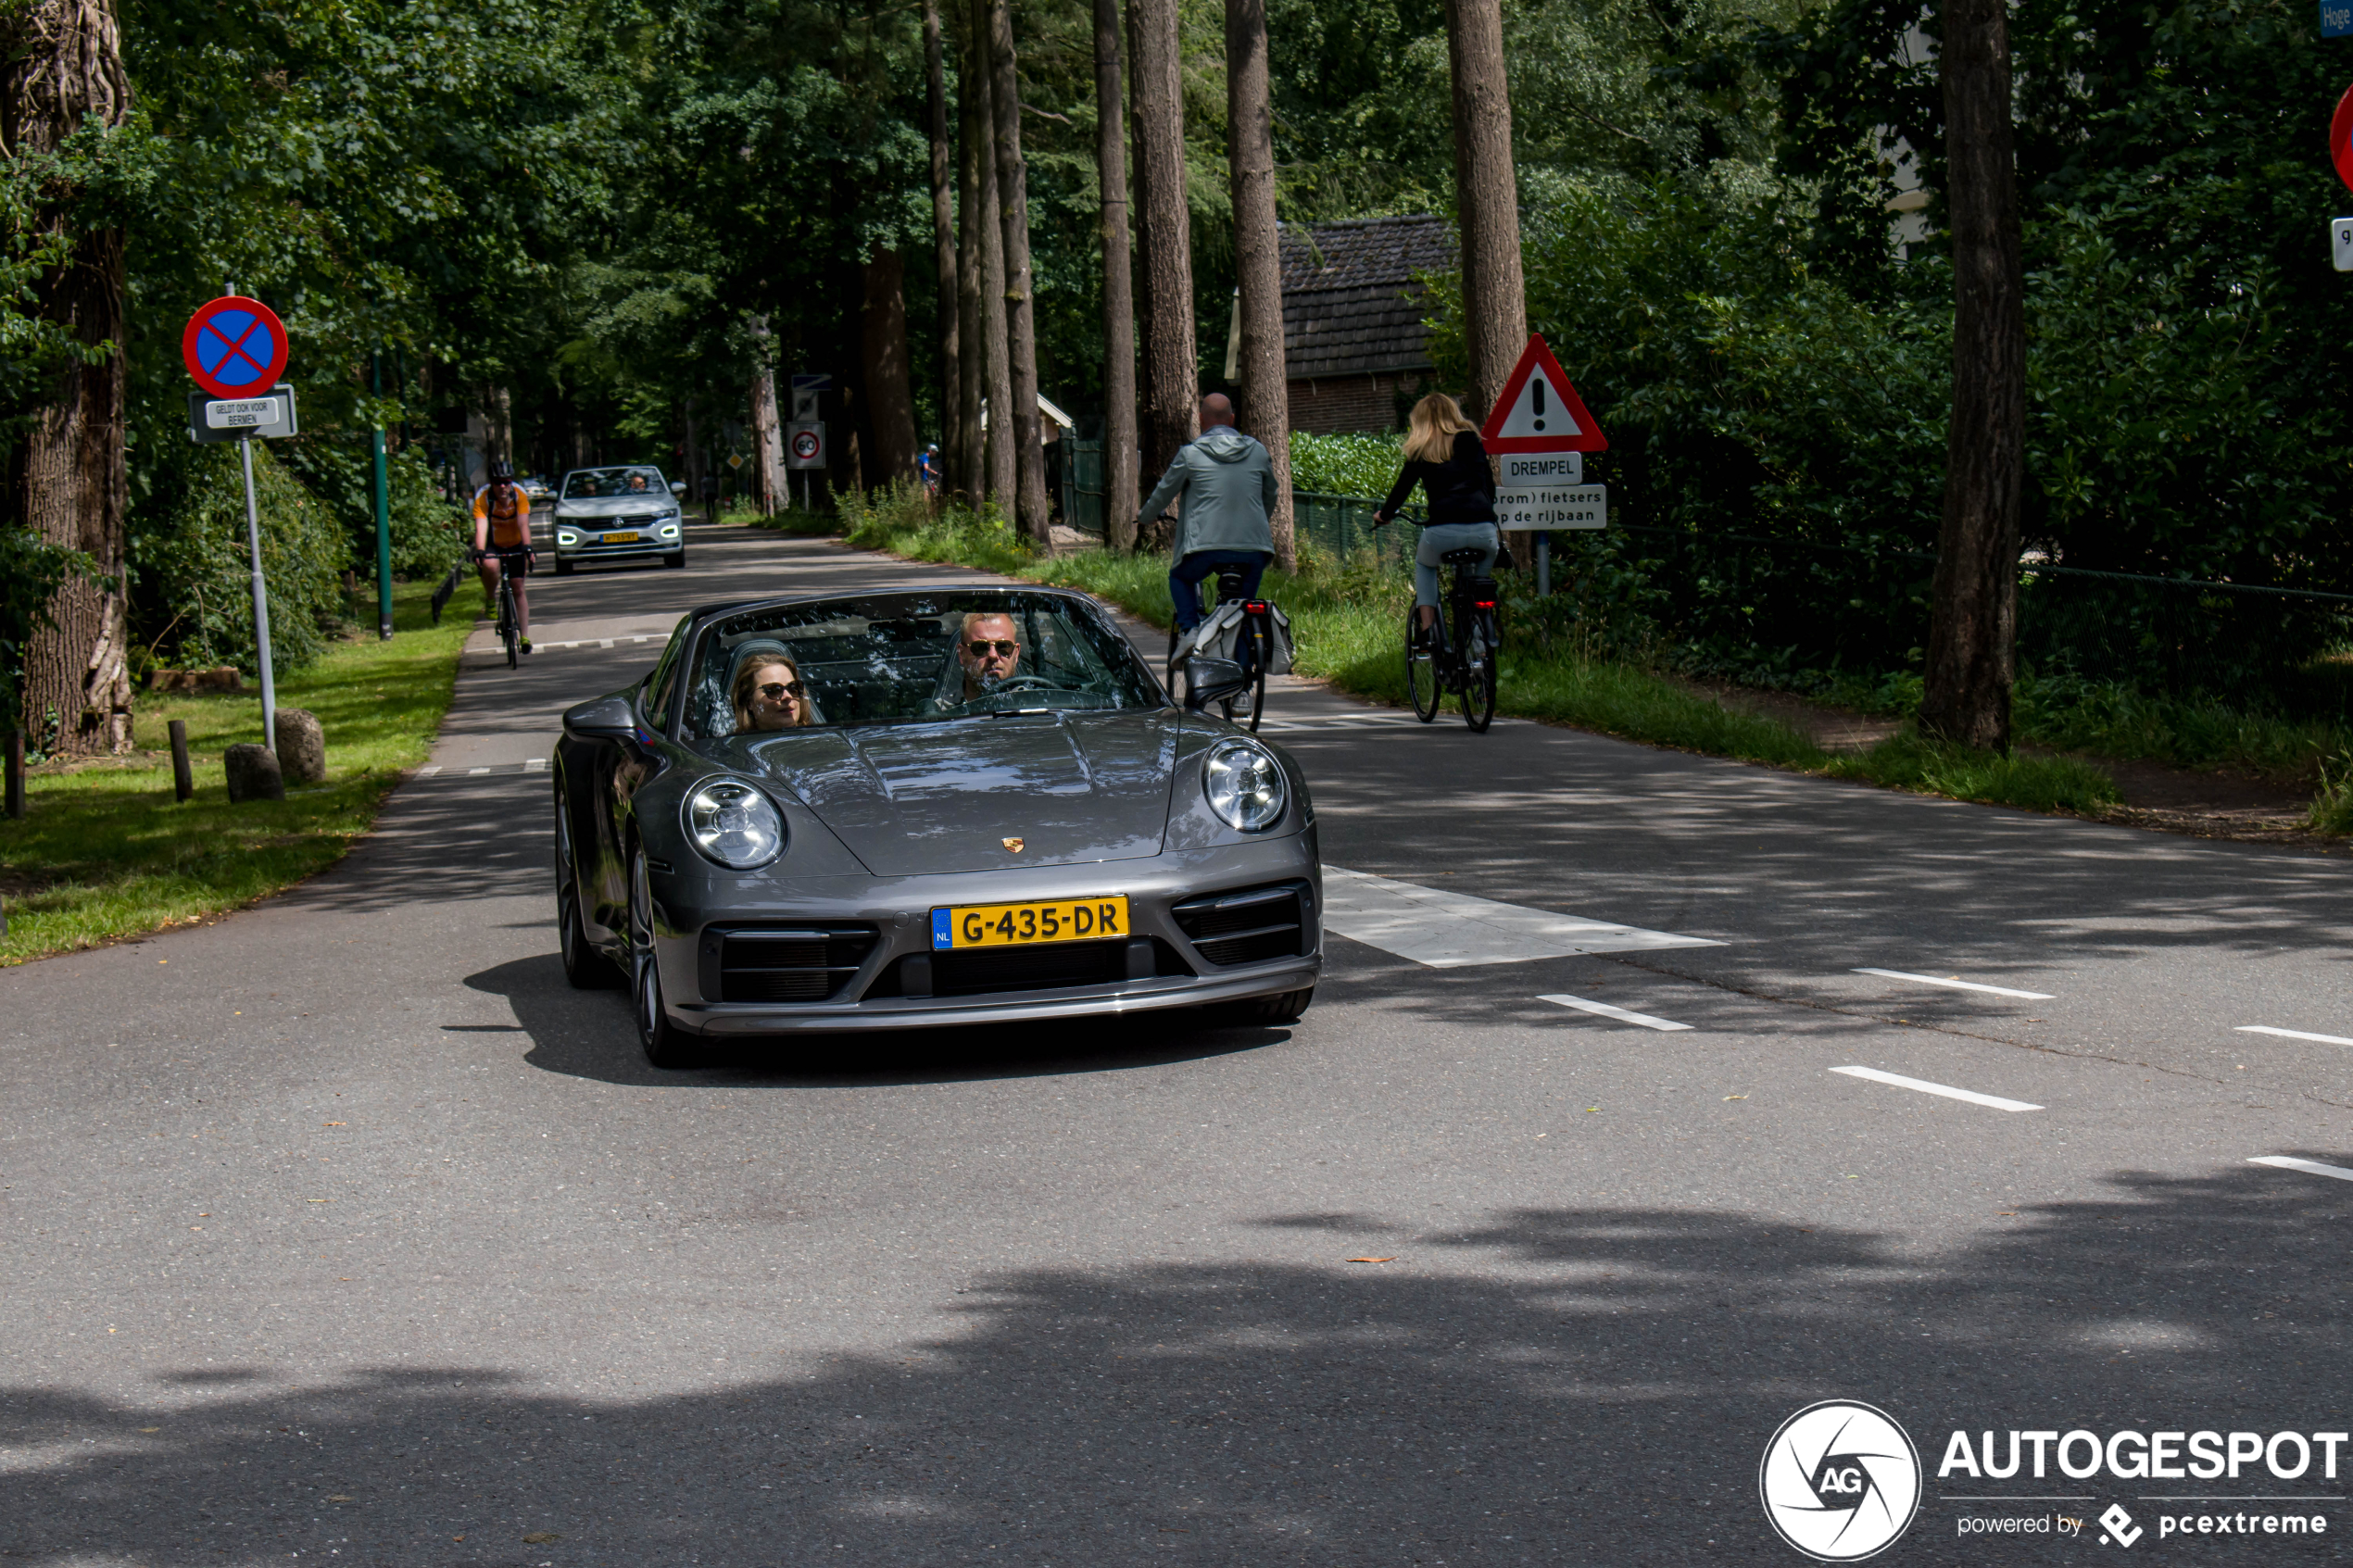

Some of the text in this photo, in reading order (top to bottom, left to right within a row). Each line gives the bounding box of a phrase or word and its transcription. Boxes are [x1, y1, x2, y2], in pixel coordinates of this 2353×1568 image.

[2322, 6, 2350, 31] Hoge
[216, 402, 268, 414] GELDT OOK VOOR
[228, 414, 258, 425] BERMEN
[798, 440, 815, 450] 60
[1510, 460, 1574, 476] DREMPEL
[1541, 492, 1602, 503] fietsers
[1515, 510, 1531, 521] de
[1538, 509, 1594, 524] rijbaan
[962, 903, 1119, 941] G-435-DR
[937, 932, 950, 942] NL
